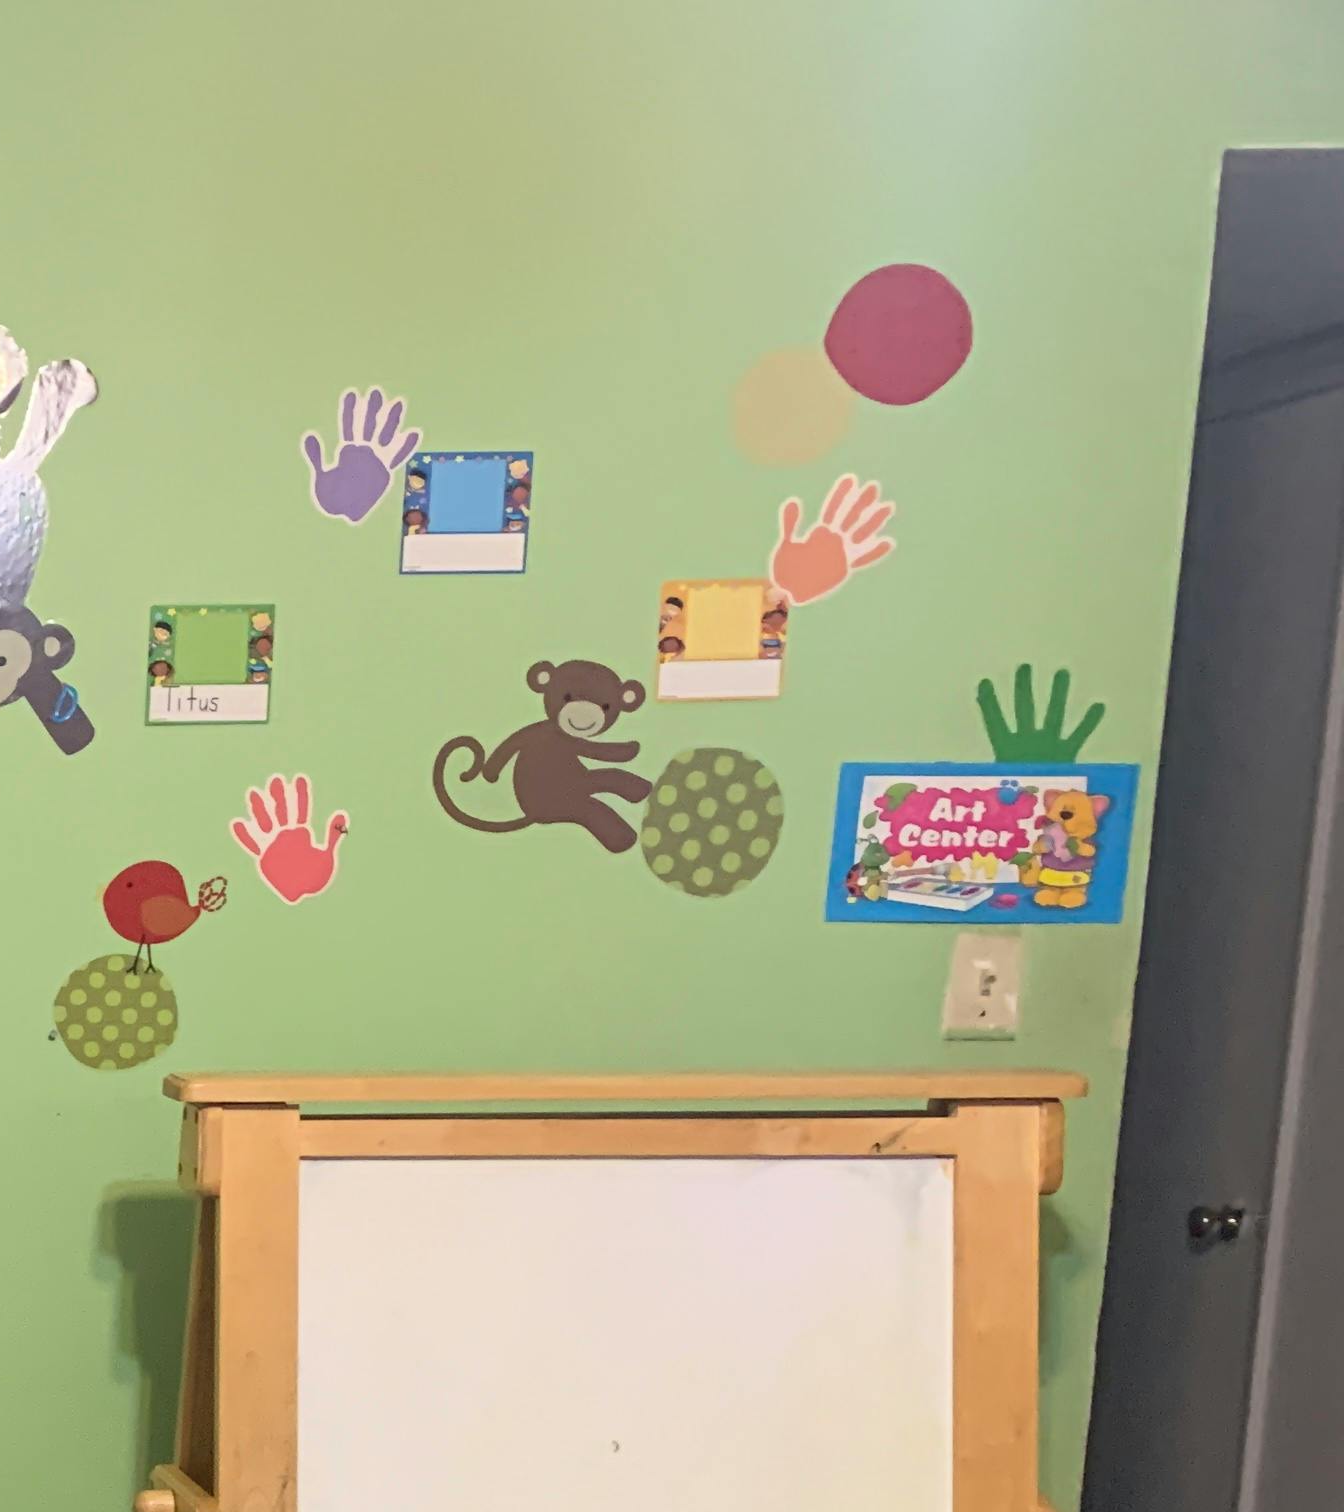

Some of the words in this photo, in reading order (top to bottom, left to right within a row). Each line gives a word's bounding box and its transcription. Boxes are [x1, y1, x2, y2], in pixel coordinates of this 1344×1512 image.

[162, 685, 220, 713] Titus
[928, 797, 987, 823] Art
[898, 823, 1016, 849] Center
